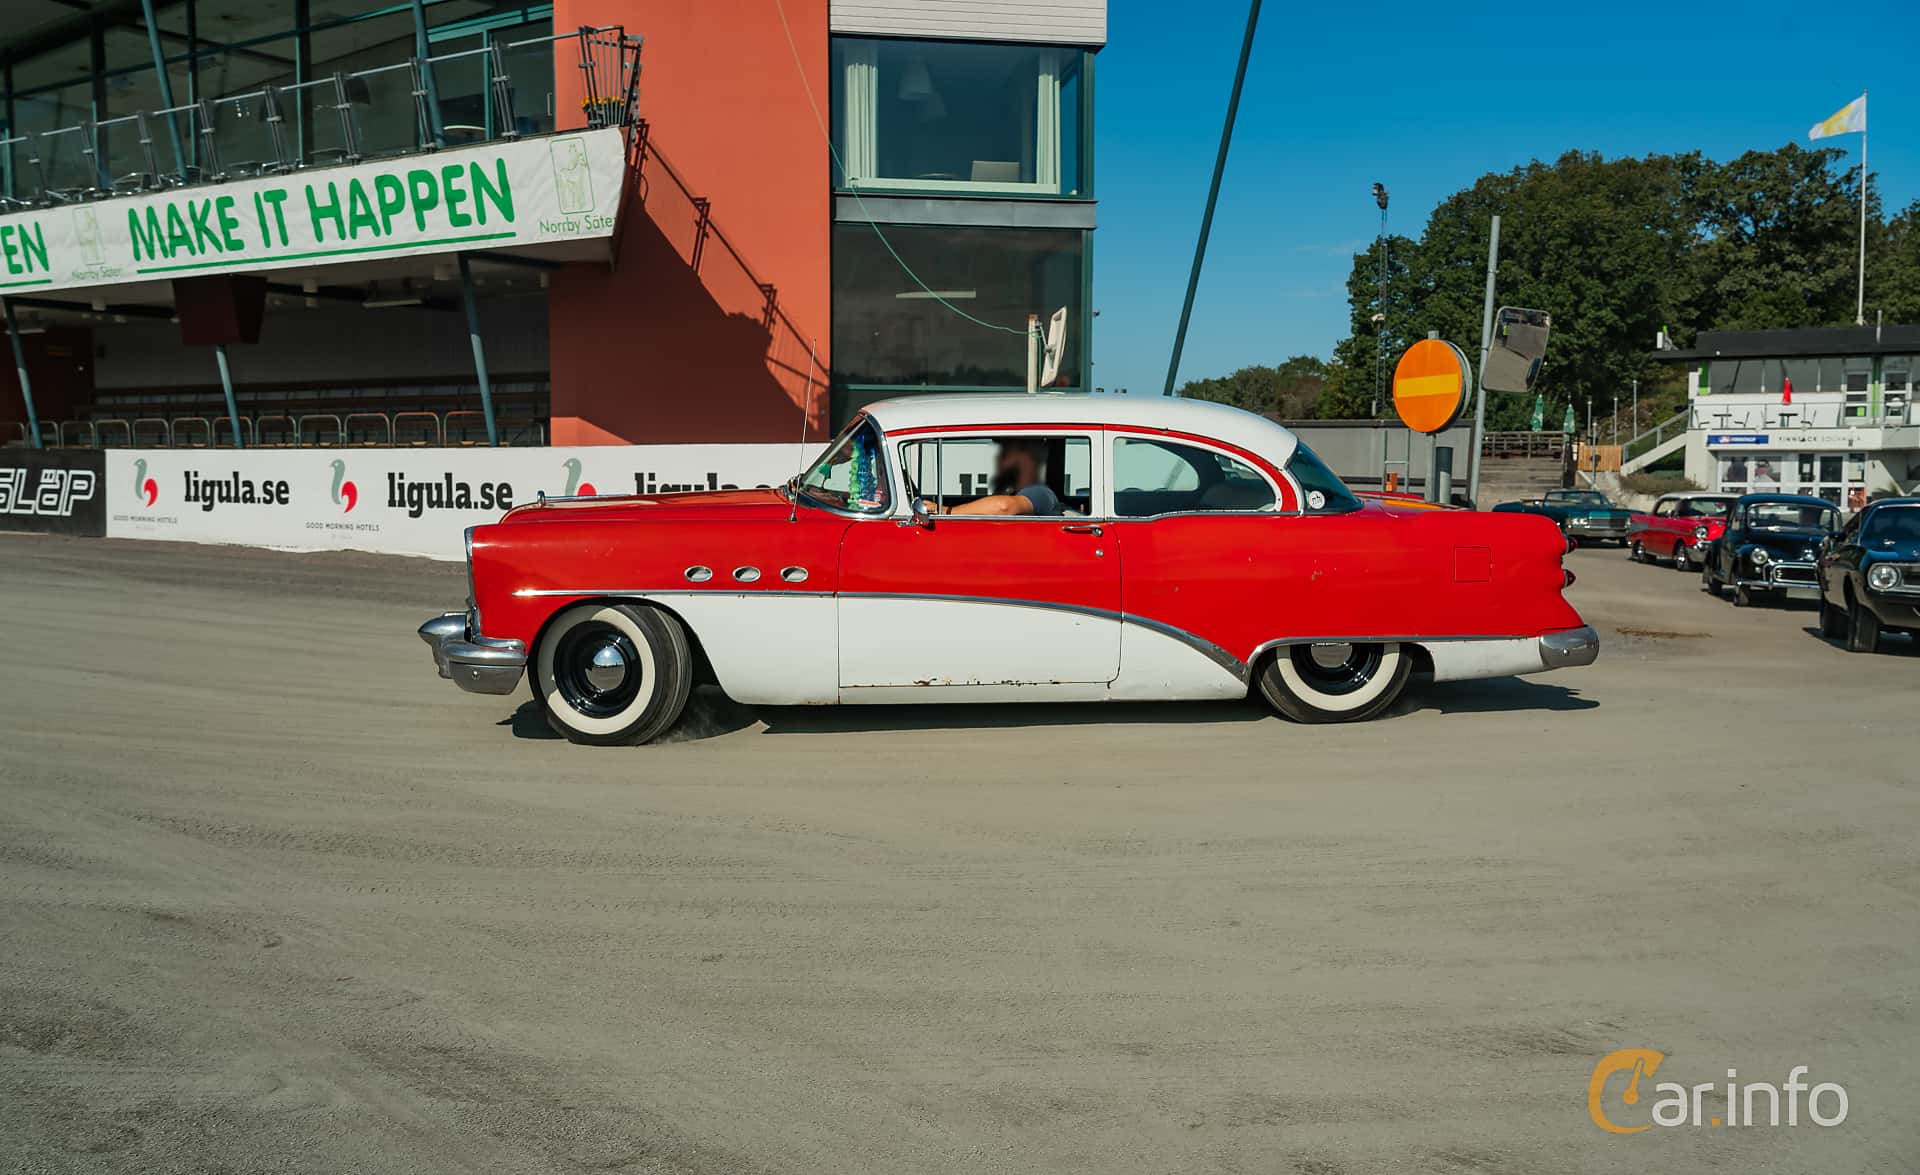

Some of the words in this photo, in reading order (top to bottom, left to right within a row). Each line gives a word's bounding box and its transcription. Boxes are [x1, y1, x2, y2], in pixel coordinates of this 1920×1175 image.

[128, 195, 245, 261] MAKE
[254, 189, 288, 248] IT
[305, 158, 515, 243] HAPPEN
[540, 216, 580, 234] Norrby
[184, 471, 289, 512] ligula.se
[388, 472, 513, 518] ligula.se
